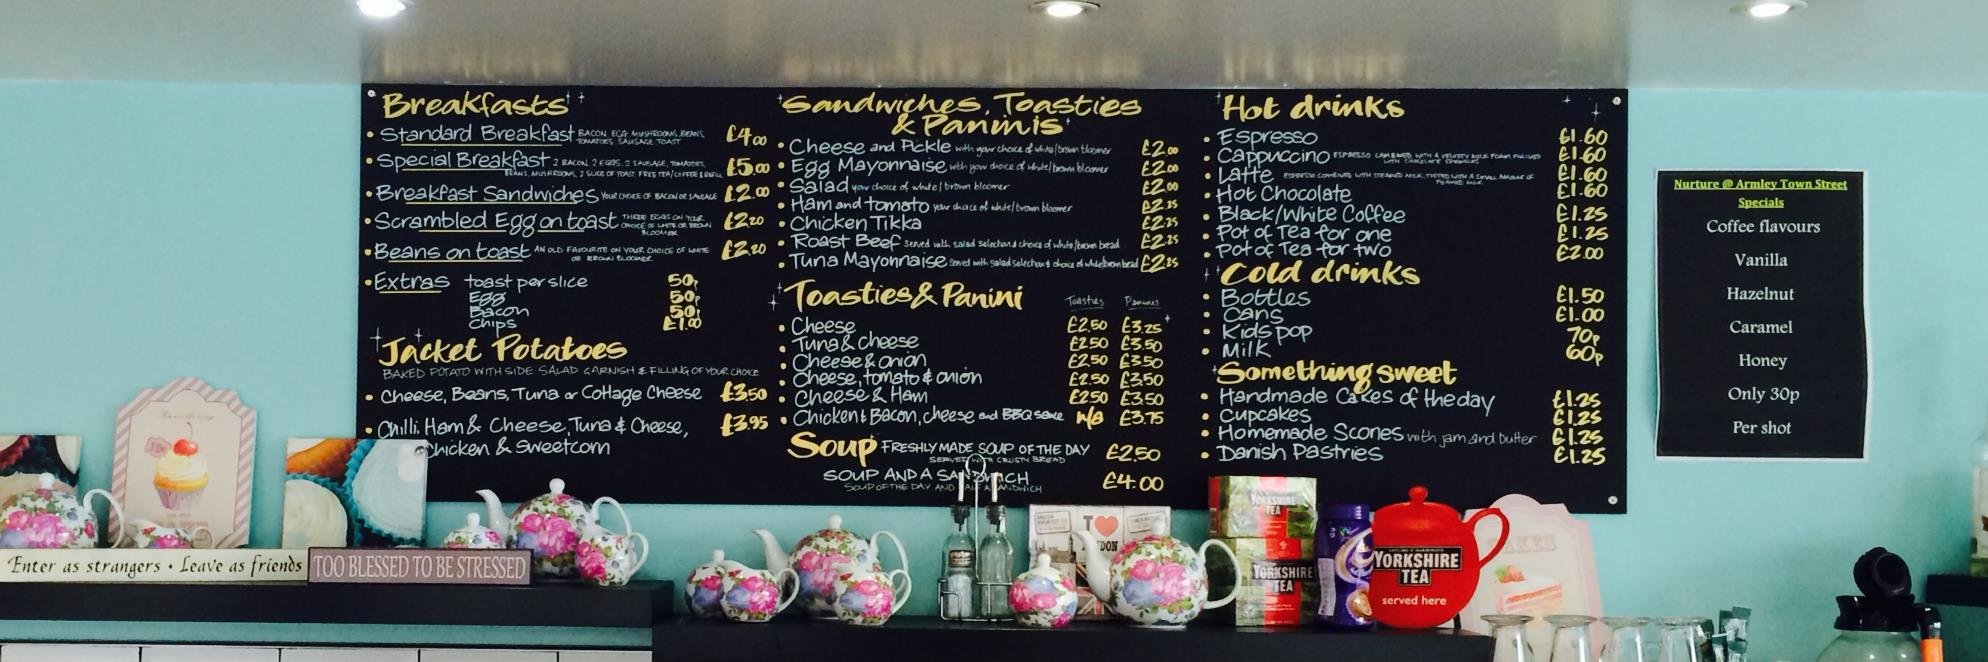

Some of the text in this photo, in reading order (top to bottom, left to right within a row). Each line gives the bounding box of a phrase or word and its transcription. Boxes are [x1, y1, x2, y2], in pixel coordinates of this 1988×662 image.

[382, 91, 570, 118] Breakfasts
[993, 92, 1142, 117] Toasties
[1222, 94, 1405, 121] Hot drinks
[380, 123, 574, 143] Standard Breakfast
[922, 114, 1064, 136] Paninis
[789, 138, 951, 155] Cheese and Pickle
[1217, 128, 1318, 151] Espresso
[377, 151, 451, 173] Special
[456, 150, 551, 171] Breakfast
[726, 157, 771, 177] £5.00
[1217, 146, 1606, 169] Cappuccino £1.60
[791, 156, 948, 180] Egg Mayonnaise
[1219, 166, 1275, 185] Latte
[375, 184, 478, 202] Breakfast
[483, 185, 600, 204] Sandwiches
[789, 176, 849, 194] Salad
[871, 182, 897, 192] choice
[1216, 184, 1352, 204] Hot Chocolate
[1674, 179, 1848, 190] Nurture @ Armley Town Street
[791, 194, 862, 213] Ham and
[1738, 197, 1784, 209] Specials
[374, 210, 620, 238] Scrambled Egg on toast
[790, 212, 922, 232] Chicken Tikka
[1217, 204, 1406, 224] Black/White Coffee
[1217, 224, 1392, 243] Pot of Tea for one
[1706, 218, 1821, 233] Coffee flavours
[374, 243, 441, 260] Beans
[446, 247, 471, 260] on
[476, 241, 532, 260] toast
[790, 233, 901, 251] Roast Beef
[788, 250, 948, 272] Tuna Mayonnaise
[1735, 253, 1789, 267] Vanilla
[374, 271, 588, 294] Extras toast per slice
[1220, 259, 1420, 286] Cold drinks
[469, 291, 507, 307] Egg
[783, 278, 1023, 313] Toasties Panini
[1221, 285, 1604, 308] Bottles £1.50
[1727, 287, 1794, 301] Hazelnut
[470, 305, 529, 318] Bacon
[1223, 307, 1284, 325] Cans
[468, 318, 518, 338] Chips
[791, 316, 857, 336] Cheese
[1222, 323, 1313, 346] Kids pop
[1729, 320, 1793, 334] Caramel
[379, 333, 628, 366] Jacket Potatoes
[791, 335, 839, 353] Tuna
[1222, 339, 1272, 358] Milk
[792, 353, 863, 372] Cheese
[1738, 353, 1788, 371] Honey
[382, 365, 760, 380] BAKED POTATO WITH SIDE SALAD GARNISH FILLING OF YOUR CHOICE
[1216, 359, 1458, 395] Something sweet
[511, 384, 702, 402] Tuna Cheese
[794, 386, 928, 408] Cheese Ham
[1220, 386, 1495, 416] Handmade Cakes the day
[1728, 387, 1800, 404] Only 30p
[425, 412, 769, 437] Ham £3.95
[793, 406, 1164, 427] Chicken £3.75
[1219, 406, 1312, 427] Cupcakes
[1218, 423, 1537, 448] Homemade Scones with jam and butter
[1733, 420, 1793, 434] Per shot
[787, 431, 1090, 468] Soup FRESHLY MADE SOUP OF THE DAY
[1216, 443, 1383, 461] Danish Pastries
[823, 468, 1164, 492] SOUP AND £4.00
[1250, 493, 1297, 506] YORKSHIRE
[7, 554, 303, 578] Enter as strangers Leave as friends
[313, 555, 526, 579] TOO BLESSED TO BE STRESSED
[1372, 550, 1459, 569] YORKSHIRE
[1253, 564, 1313, 580] YORKSHIRE
[1401, 569, 1429, 584] TEA
[1272, 580, 1294, 593] TEA
[1382, 595, 1447, 605] served here
